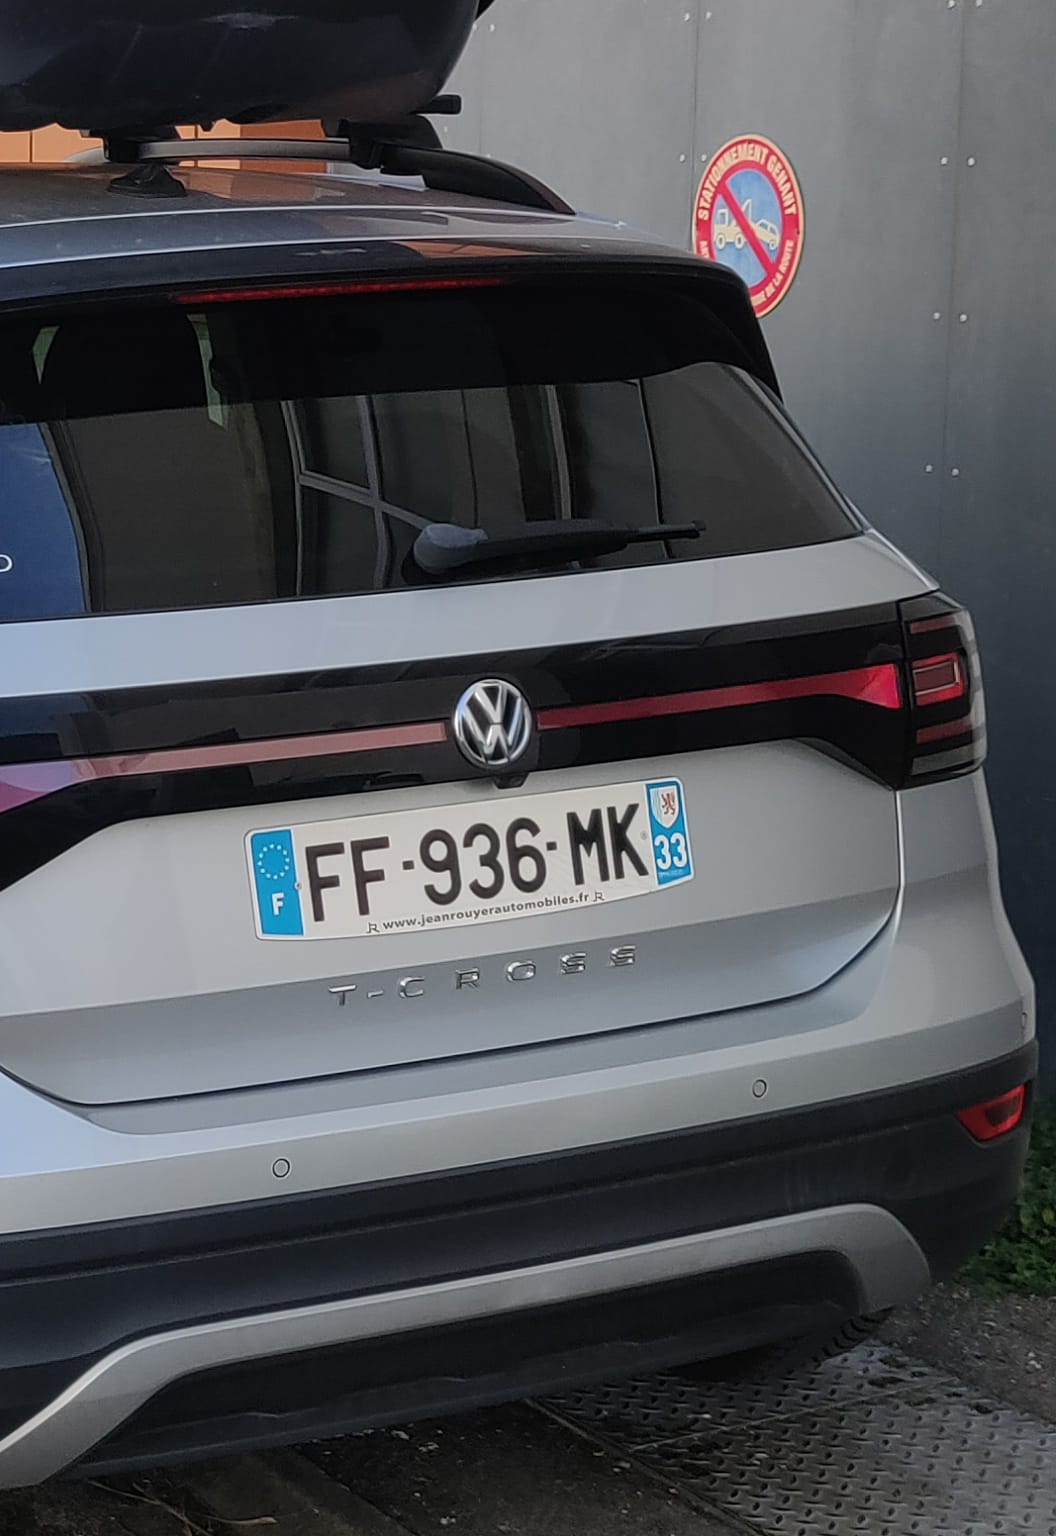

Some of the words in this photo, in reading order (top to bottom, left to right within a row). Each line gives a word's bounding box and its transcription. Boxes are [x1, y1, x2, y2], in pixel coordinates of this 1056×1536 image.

[699, 143, 768, 220] STATIONNEMENT
[305, 803, 649, 922] FF-936-MK
[654, 832, 688, 870] 33
[271, 893, 285, 915] F
[383, 892, 589, 930] www.jeanrouyerautomobiles.fr
[329, 944, 637, 1006] T-CROSS
